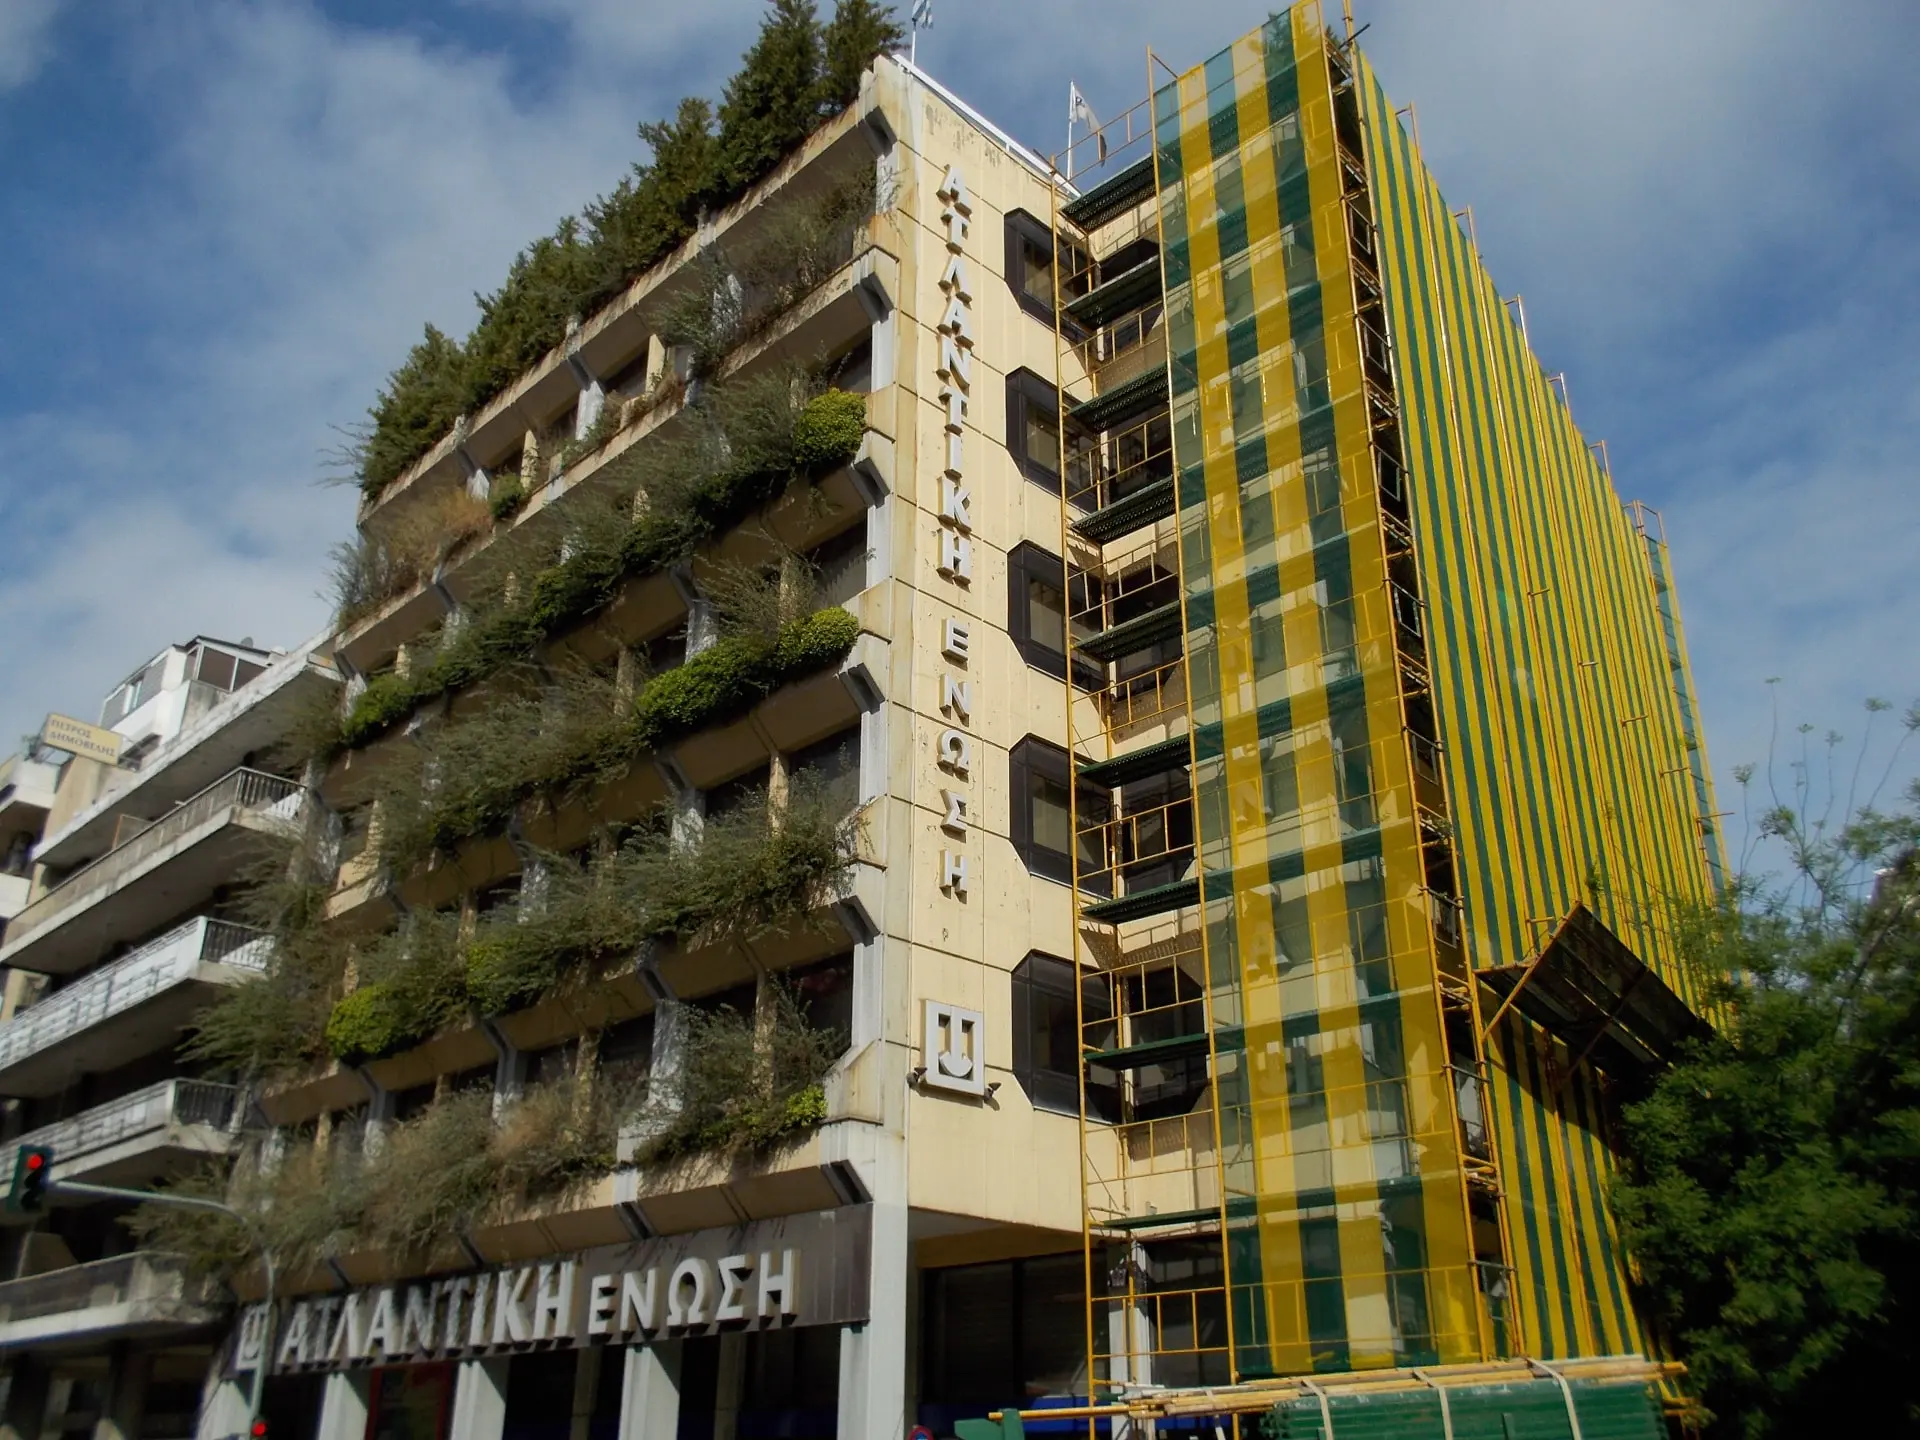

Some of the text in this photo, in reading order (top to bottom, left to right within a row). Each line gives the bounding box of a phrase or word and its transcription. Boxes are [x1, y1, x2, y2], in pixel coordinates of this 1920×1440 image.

[935, 164, 973, 897] ΑΤΛΑΝΤΙΚΗ ΕΝΩΣΗ
[280, 1249, 797, 1364] ΑΤΛΑΝΤΙΚΗ ΕΝΩΣΗ
